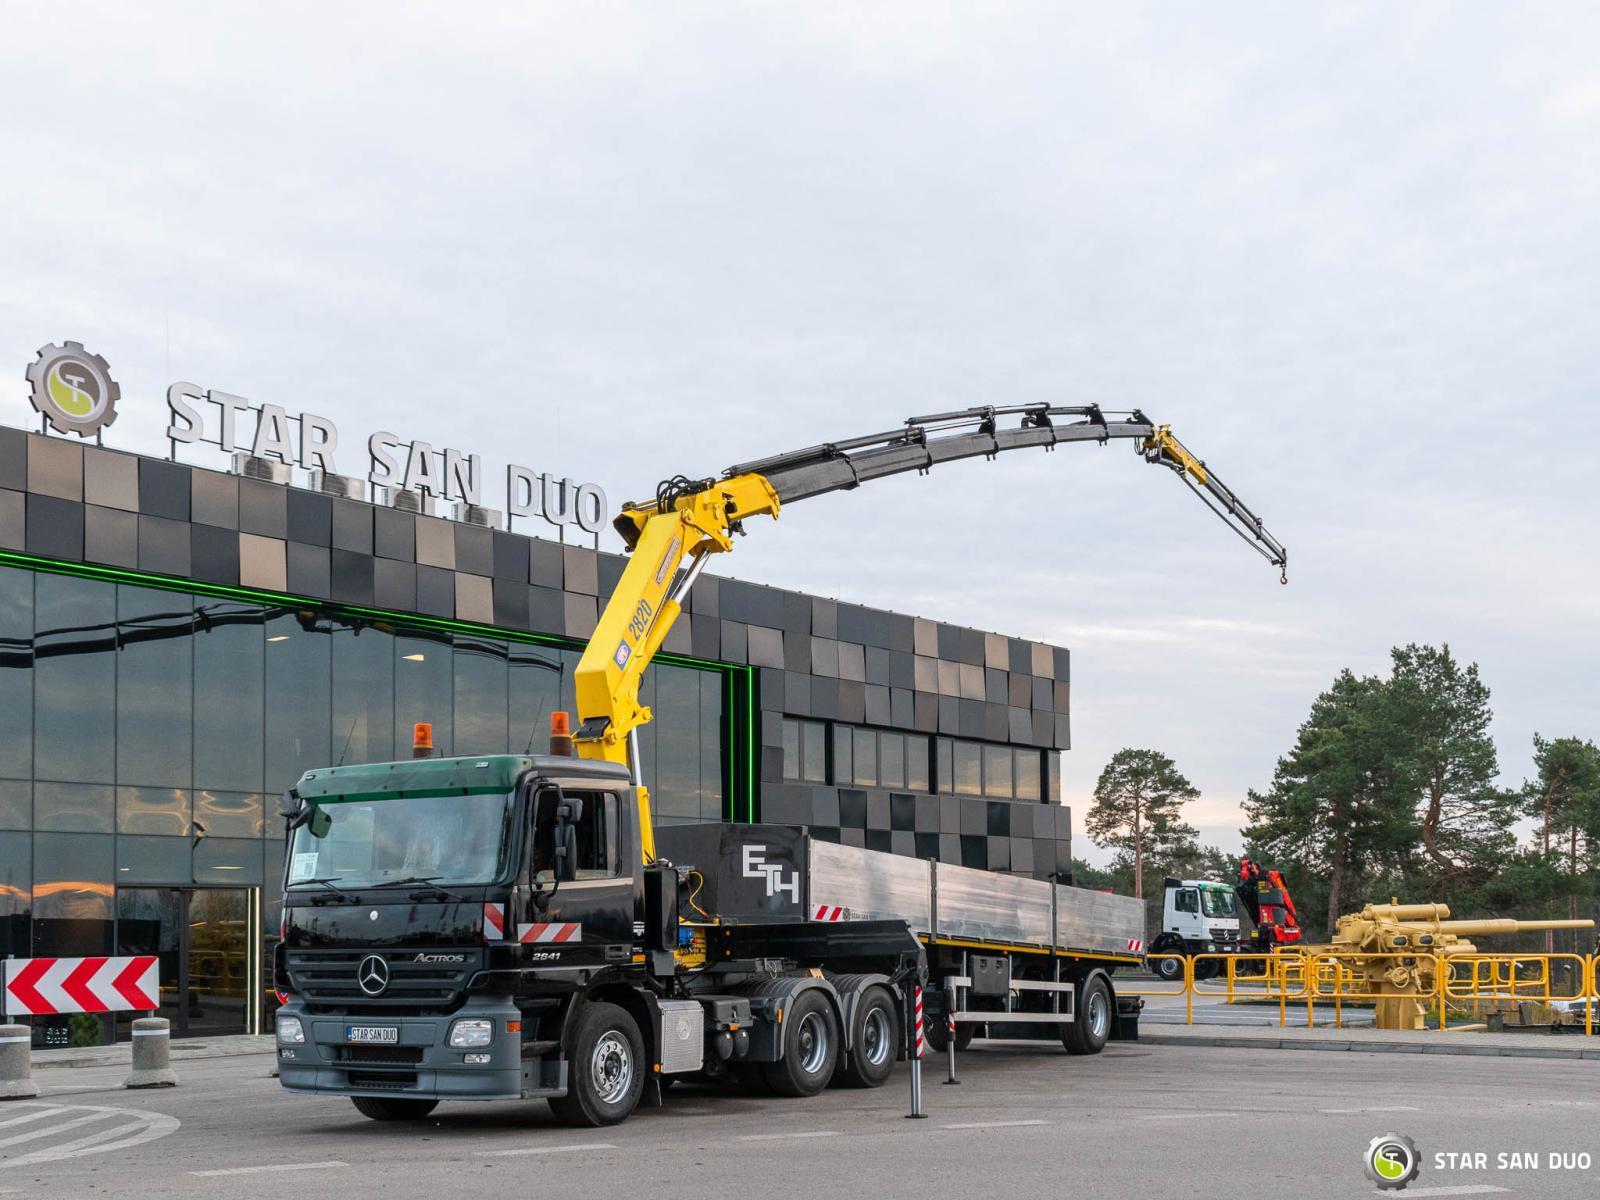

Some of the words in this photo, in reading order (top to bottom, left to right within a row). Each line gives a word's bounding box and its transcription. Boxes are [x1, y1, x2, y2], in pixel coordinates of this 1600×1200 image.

[167, 381, 339, 474] STAR
[368, 431, 481, 506] SAN
[507, 464, 608, 533] DUO
[628, 598, 654, 642] 2820
[532, 952, 561, 961] 2641
[352, 1028, 369, 1040] STAR
[369, 1029, 382, 1041] SAN
[383, 1029, 396, 1041] DUO
